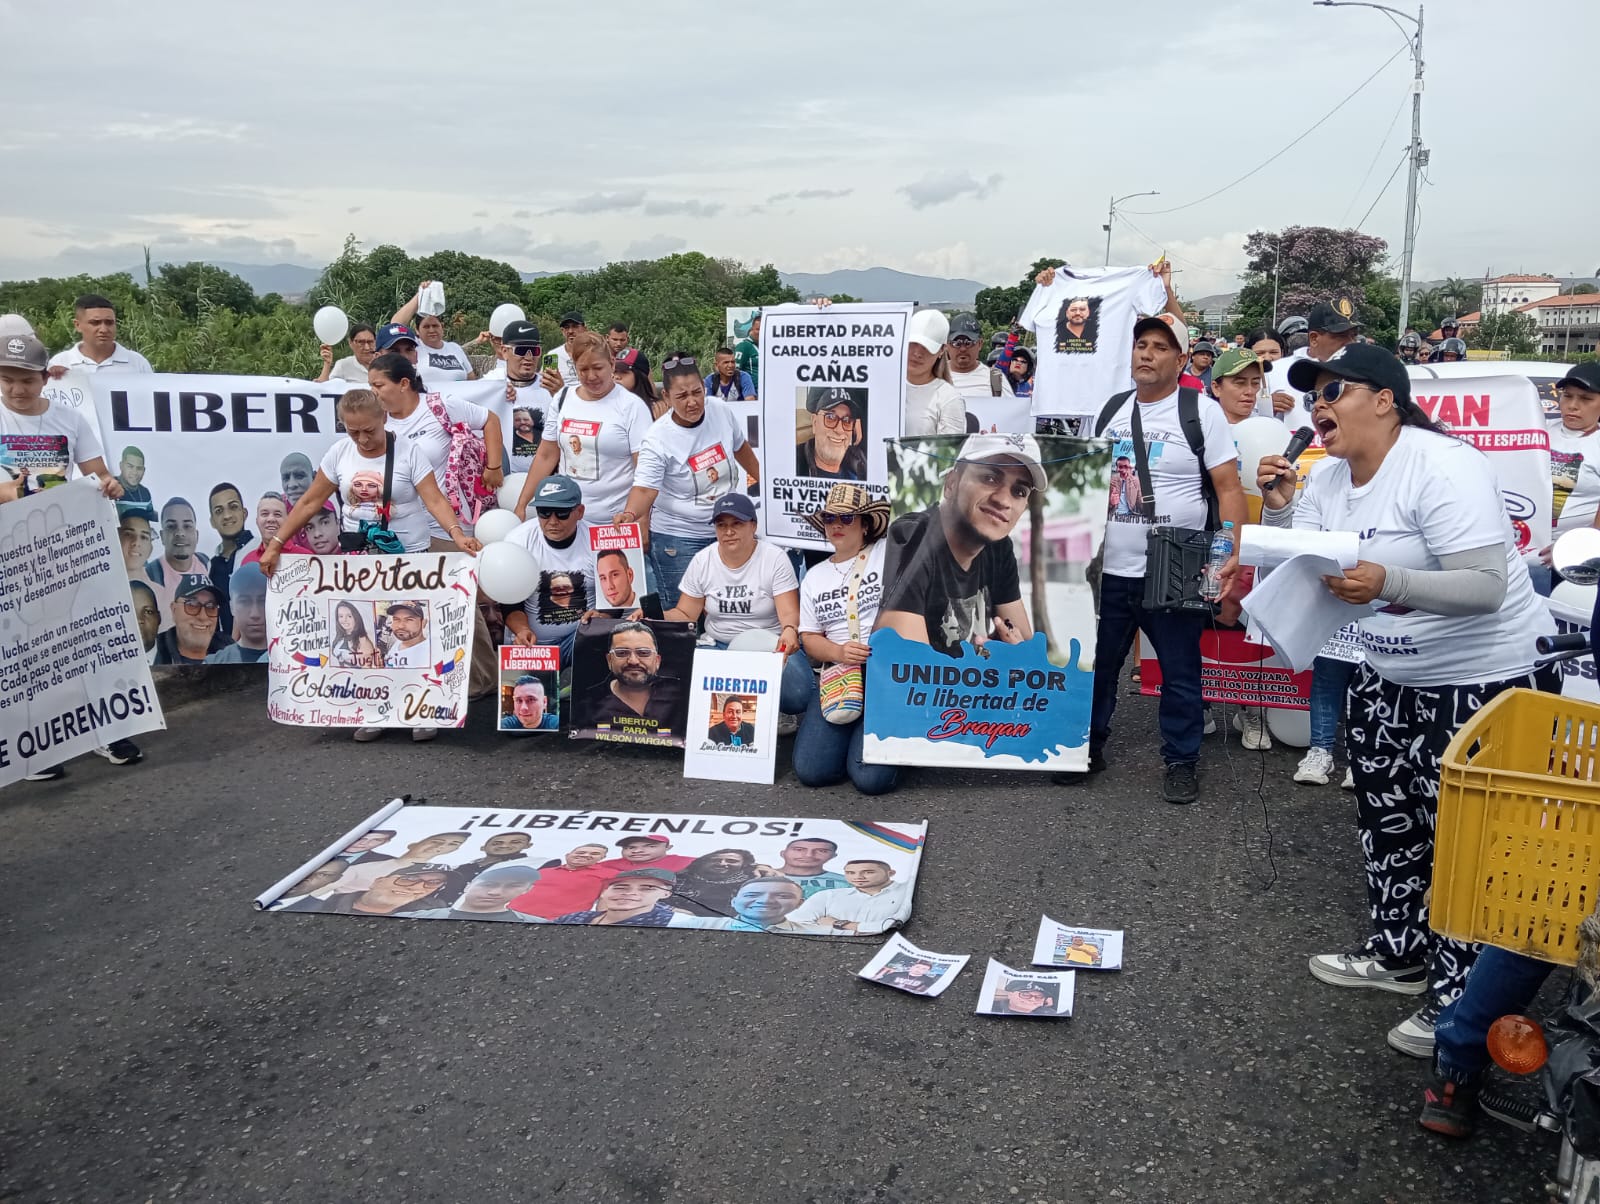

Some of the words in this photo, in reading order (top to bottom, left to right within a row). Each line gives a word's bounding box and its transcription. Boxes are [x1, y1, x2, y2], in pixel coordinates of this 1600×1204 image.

[772, 325, 847, 338] LIBERTAD
[851, 324, 895, 337] PARA
[772, 345, 828, 357] CARLOS
[831, 345, 894, 357] ALBERTO
[796, 360, 869, 383] CAÑAS
[1478, 434, 1491, 447] TE
[1494, 432, 1546, 447] ESPERAN
[773, 488, 793, 500] EN
[33, 533, 64, 550] fuerza,
[65, 519, 96, 539] siempre
[593, 539, 626, 550] LIBERTAD
[627, 537, 638, 547] YA!
[30, 558, 35, 573] y
[37, 553, 47, 566] te
[48, 541, 83, 562] llevamos
[86, 535, 95, 545] en
[96, 527, 105, 541] el
[56, 561, 69, 575] tus
[70, 546, 111, 569] hermanos
[310, 555, 446, 594] Libertad
[16, 596, 22, 611] y
[24, 580, 66, 602] deseamos
[68, 560, 110, 585] abrazarte
[725, 584, 747, 598] YEE
[719, 599, 752, 615] HAW
[2, 640, 30, 660] lucha
[31, 630, 54, 647] serán
[56, 625, 67, 638] un
[69, 601, 130, 632] recordatorio
[21, 654, 38, 671] que
[40, 647, 49, 659] se
[51, 628, 98, 654] encuentra
[99, 623, 113, 635] en
[115, 615, 126, 630] el
[0, 673, 28, 692] Cada
[30, 665, 51, 684] paso
[53, 655, 70, 673] que
[73, 642, 105, 661] damos,
[107, 630, 137, 648] cada
[509, 647, 551, 660] ¡EXIGIMOS
[504, 660, 543, 670] LIBERTAD
[544, 660, 557, 670] YA!
[13, 691, 24, 702] un
[27, 679, 49, 701] grito
[51, 672, 63, 686] de
[65, 664, 88, 680] amor
[90, 660, 96, 674] y
[703, 676, 768, 695] LIBERTAD
[891, 663, 1000, 688] UNIDOS
[1008, 669, 1067, 692] POR
[1225, 670, 1237, 679] LA
[1239, 671, 1260, 680] VOZ
[1262, 672, 1290, 682] PARA
[291, 672, 389, 700] Colombianos
[1220, 691, 1238, 700] LOS
[1223, 681, 1242, 690] LOS
[1243, 682, 1298, 694] DERECHOS
[378, 700, 393, 715] en
[907, 687, 927, 706] la
[932, 689, 1018, 711] libertad
[1023, 692, 1049, 712] de
[17, 685, 153, 758] QUEREMOS!
[613, 716, 659, 727] LIBERTAD
[623, 727, 648, 735] PARA
[927, 709, 1032, 748] Brayan
[595, 733, 632, 743] WILSON
[634, 736, 673, 747] VARGAS
[459, 810, 804, 837] ¡LIBÉRENLOS!
